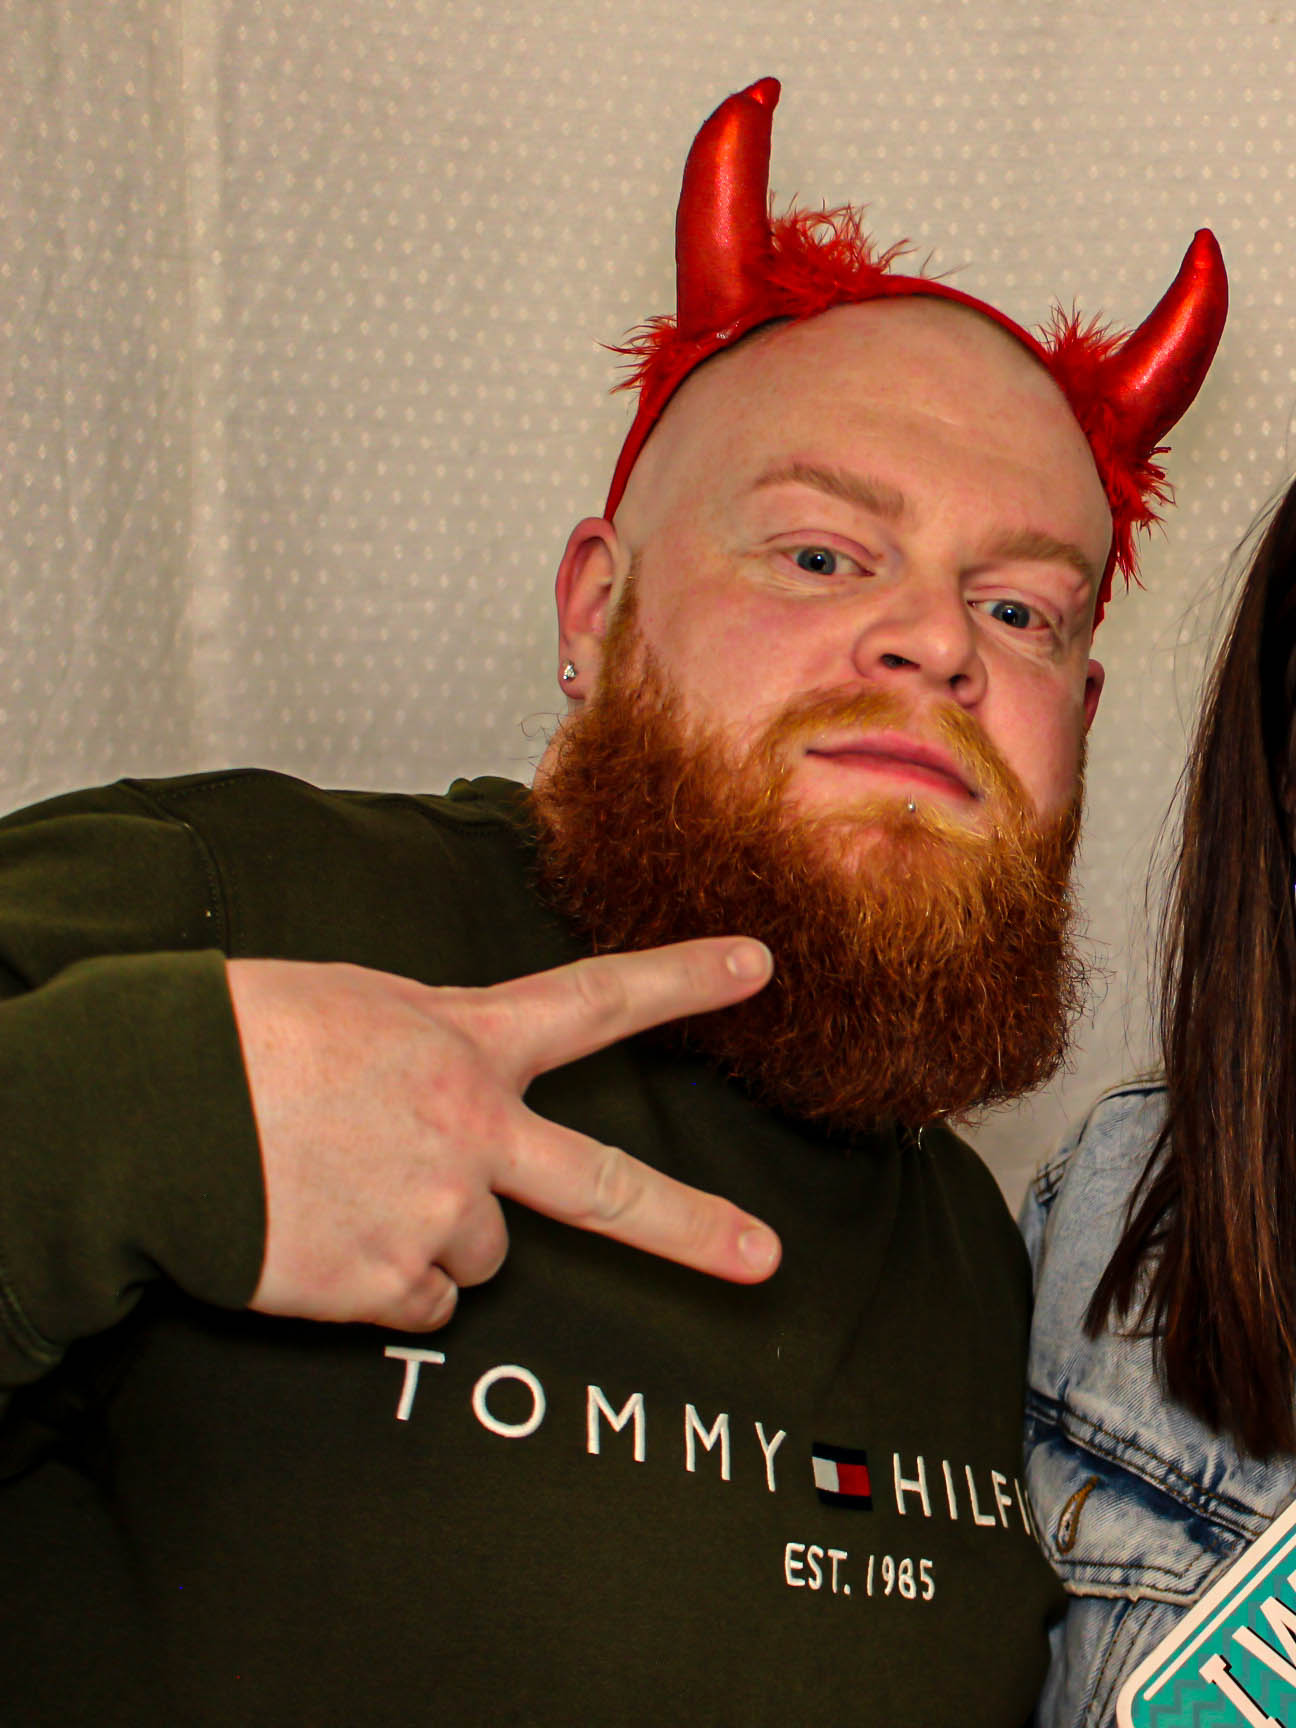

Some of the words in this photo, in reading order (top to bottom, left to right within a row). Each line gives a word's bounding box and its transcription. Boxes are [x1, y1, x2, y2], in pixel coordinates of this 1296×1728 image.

[384, 1345, 786, 1492] TOMMY
[893, 1452, 1039, 1545] HILFI
[785, 1542, 851, 1596] EST.
[866, 1554, 935, 1601] 1985
[1199, 1653, 1284, 1728] I
